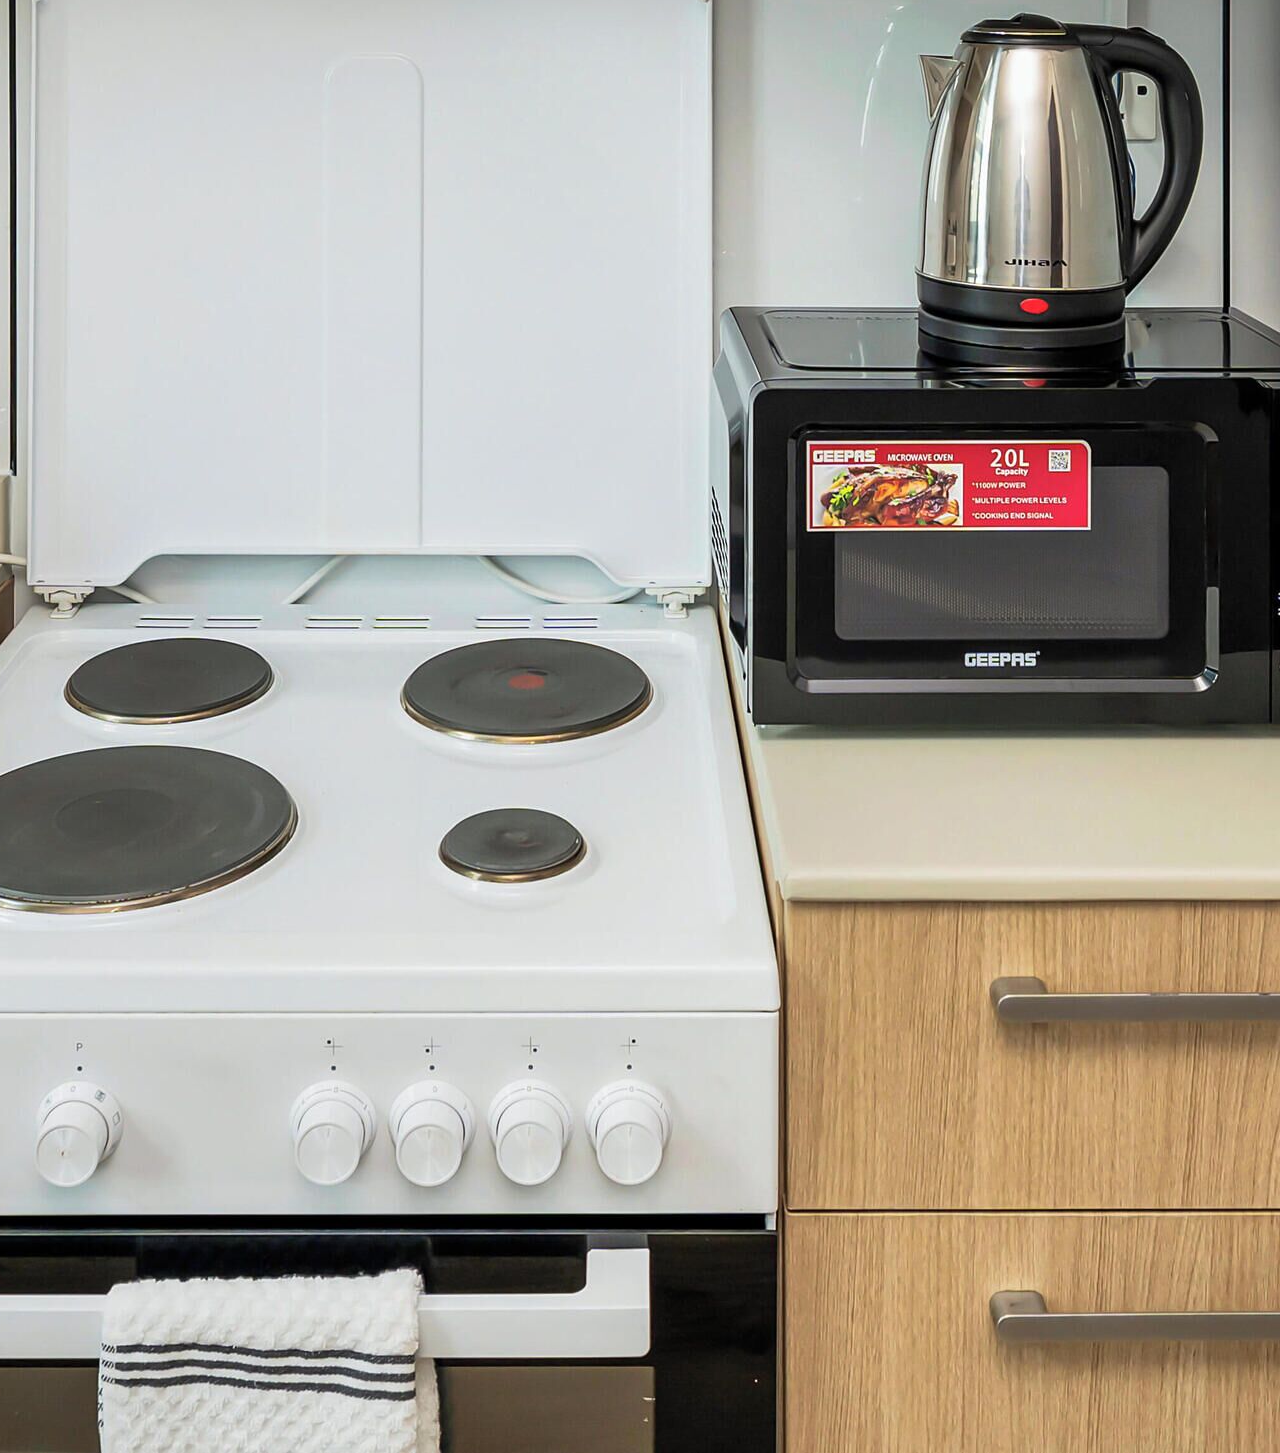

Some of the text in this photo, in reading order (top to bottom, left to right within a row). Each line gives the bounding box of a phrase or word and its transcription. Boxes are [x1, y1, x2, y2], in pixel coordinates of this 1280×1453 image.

[813, 450, 876, 463] GEEPAS
[887, 453, 954, 462] MICROWAVE OVEN
[990, 448, 1030, 468] 20L
[995, 467, 1029, 477] Capacity
[964, 652, 1037, 667] GEEPAS
[76, 1042, 83, 1052] P
